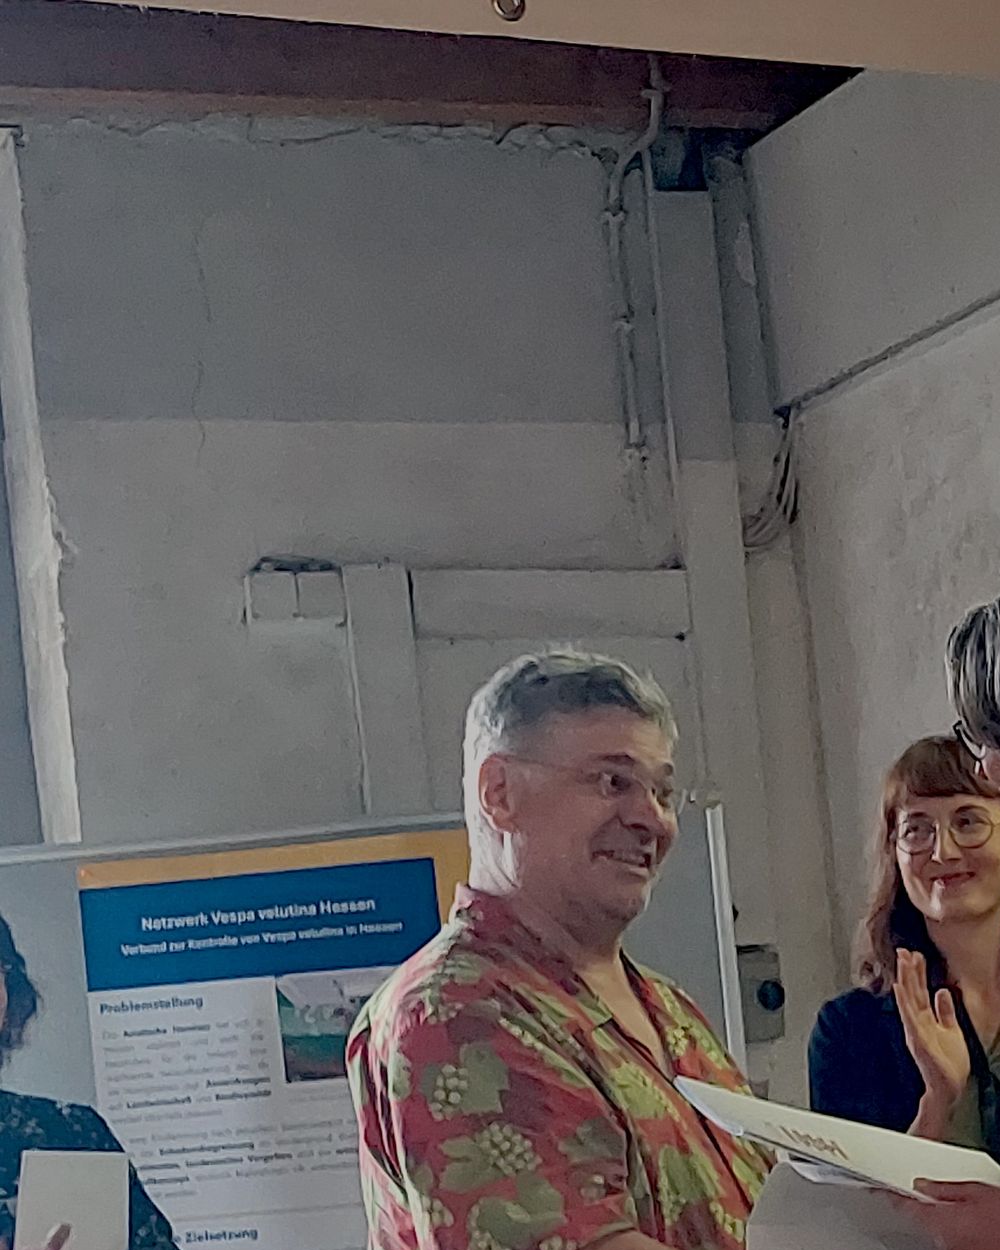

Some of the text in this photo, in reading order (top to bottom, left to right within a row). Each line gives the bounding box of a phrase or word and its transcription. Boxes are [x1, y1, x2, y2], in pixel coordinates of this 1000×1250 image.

[141, 898, 376, 931] Netzwerk Vespa velutina Hessen
[99, 996, 204, 1015] Problemstellung
[185, 1228, 259, 1243] Zielsetzung
